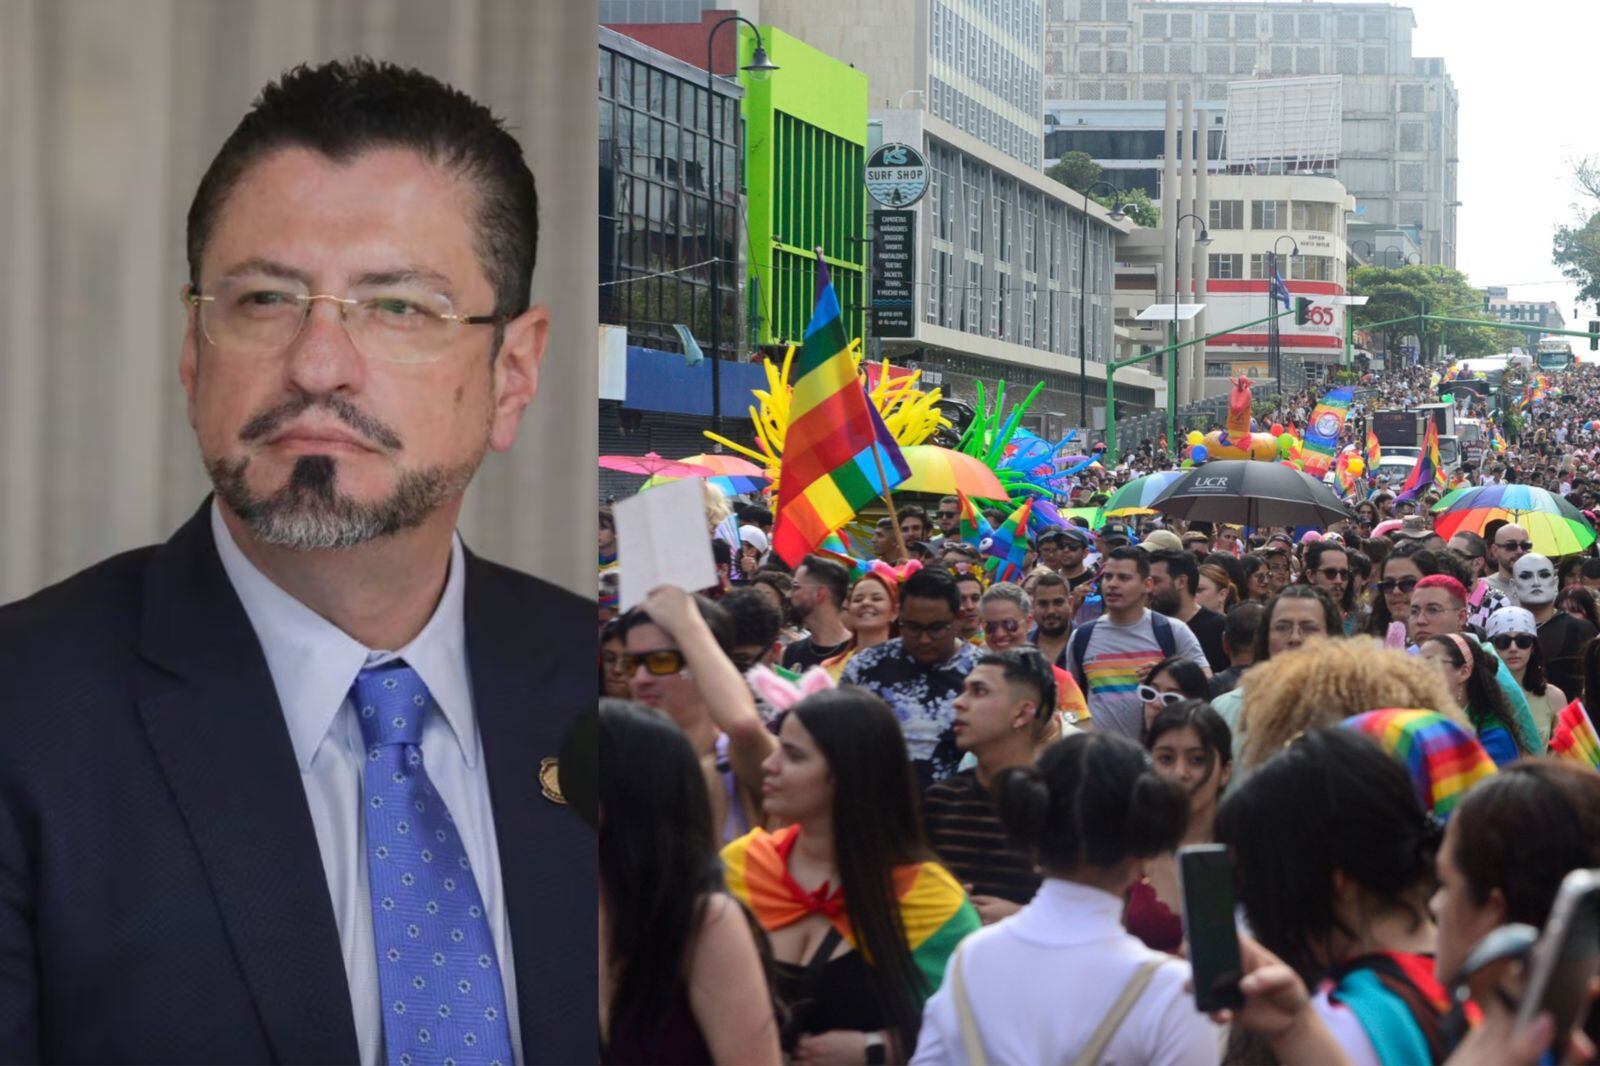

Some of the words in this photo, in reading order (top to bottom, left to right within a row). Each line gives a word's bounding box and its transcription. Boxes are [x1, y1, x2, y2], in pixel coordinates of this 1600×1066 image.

[868, 170, 893, 181] SURF
[897, 169, 924, 180] SHOP
[1195, 477, 1229, 487] UCR
